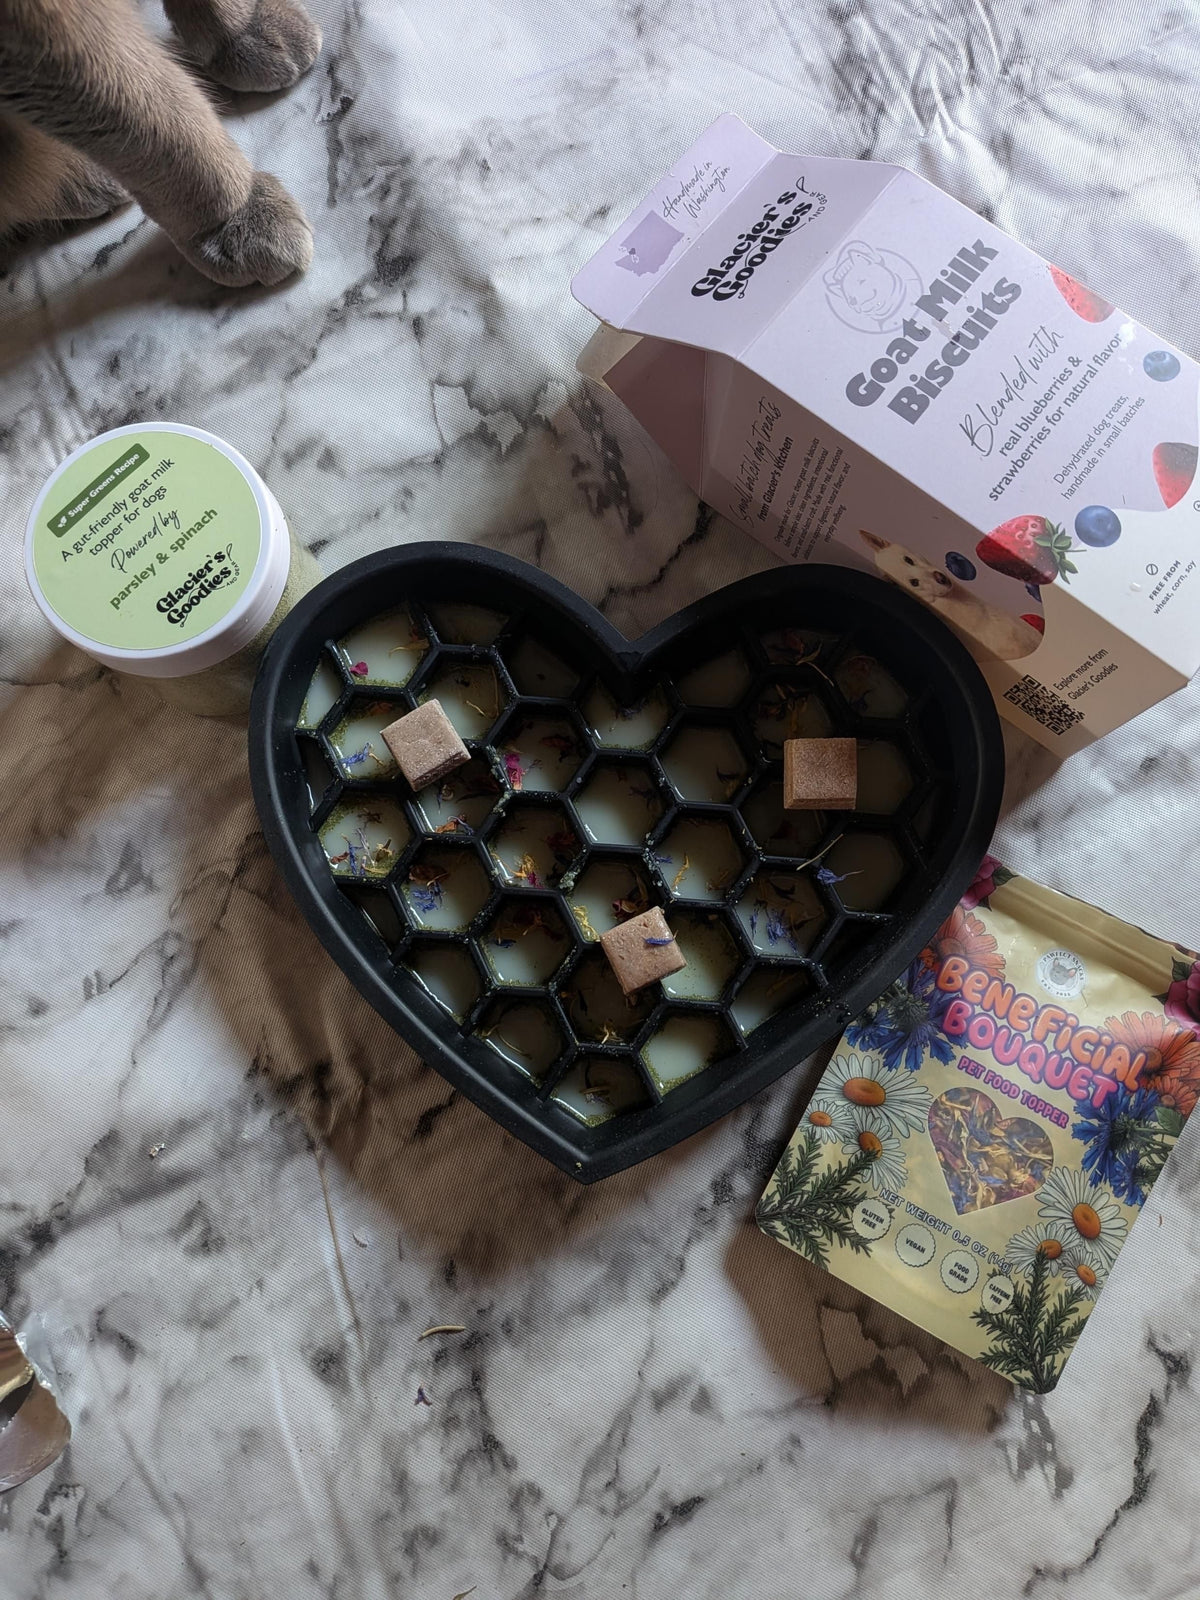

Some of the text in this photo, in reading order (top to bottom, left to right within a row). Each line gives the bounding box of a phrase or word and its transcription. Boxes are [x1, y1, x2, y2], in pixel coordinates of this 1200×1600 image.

[662, 161, 713, 219] Handmade in
[683, 166, 731, 219] Washington
[808, 191, 828, 222] AND GEAR
[691, 191, 797, 297] Glacier's
[712, 202, 813, 301] Goodies
[845, 238, 1000, 407] Goat Milk
[887, 277, 1022, 425] Biscuits
[751, 396, 781, 442] treats
[959, 325, 1064, 457] Blended with
[989, 333, 1122, 501] strawberries for natural flavor
[999, 356, 1083, 457] real blueberries &
[1053, 394, 1129, 484] Dehydrated dog treats,
[1061, 396, 1145, 500] handmade in small batches
[61, 458, 175, 562] A gut-friendly goat milk
[68, 453, 140, 518] Super Greens Recipe
[757, 502, 769, 522] from
[763, 470, 781, 504] Glacier's
[89, 485, 168, 556] topper for dogs
[111, 509, 181, 573] Powered by
[110, 508, 218, 611] parsley & spinach
[156, 551, 226, 613] Glacier's
[226, 577, 237, 586] AND
[1148, 560, 1181, 601] FREE FROM
[1154, 560, 1197, 615] wheat, corn, soy
[167, 566, 232, 624] Goodies
[1053, 648, 1109, 691] Explore more from
[1067, 663, 1119, 700] Glacier's Goodies
[942, 999, 1120, 1108] BOUQUET
[957, 1055, 1070, 1129] PET FOOD TOPPER
[861, 1207, 885, 1225] GLUTEN
[861, 1217, 877, 1230] FREE
[880, 1187, 905, 1207] NET
[905, 1202, 952, 1235] WEIGHT
[952, 1230, 971, 1246] 0.5
[971, 1240, 990, 1258] OZ
[905, 1237, 926, 1255] VEGAN
[948, 1269, 968, 1284] GRADE
[953, 1261, 970, 1275] FOOD
